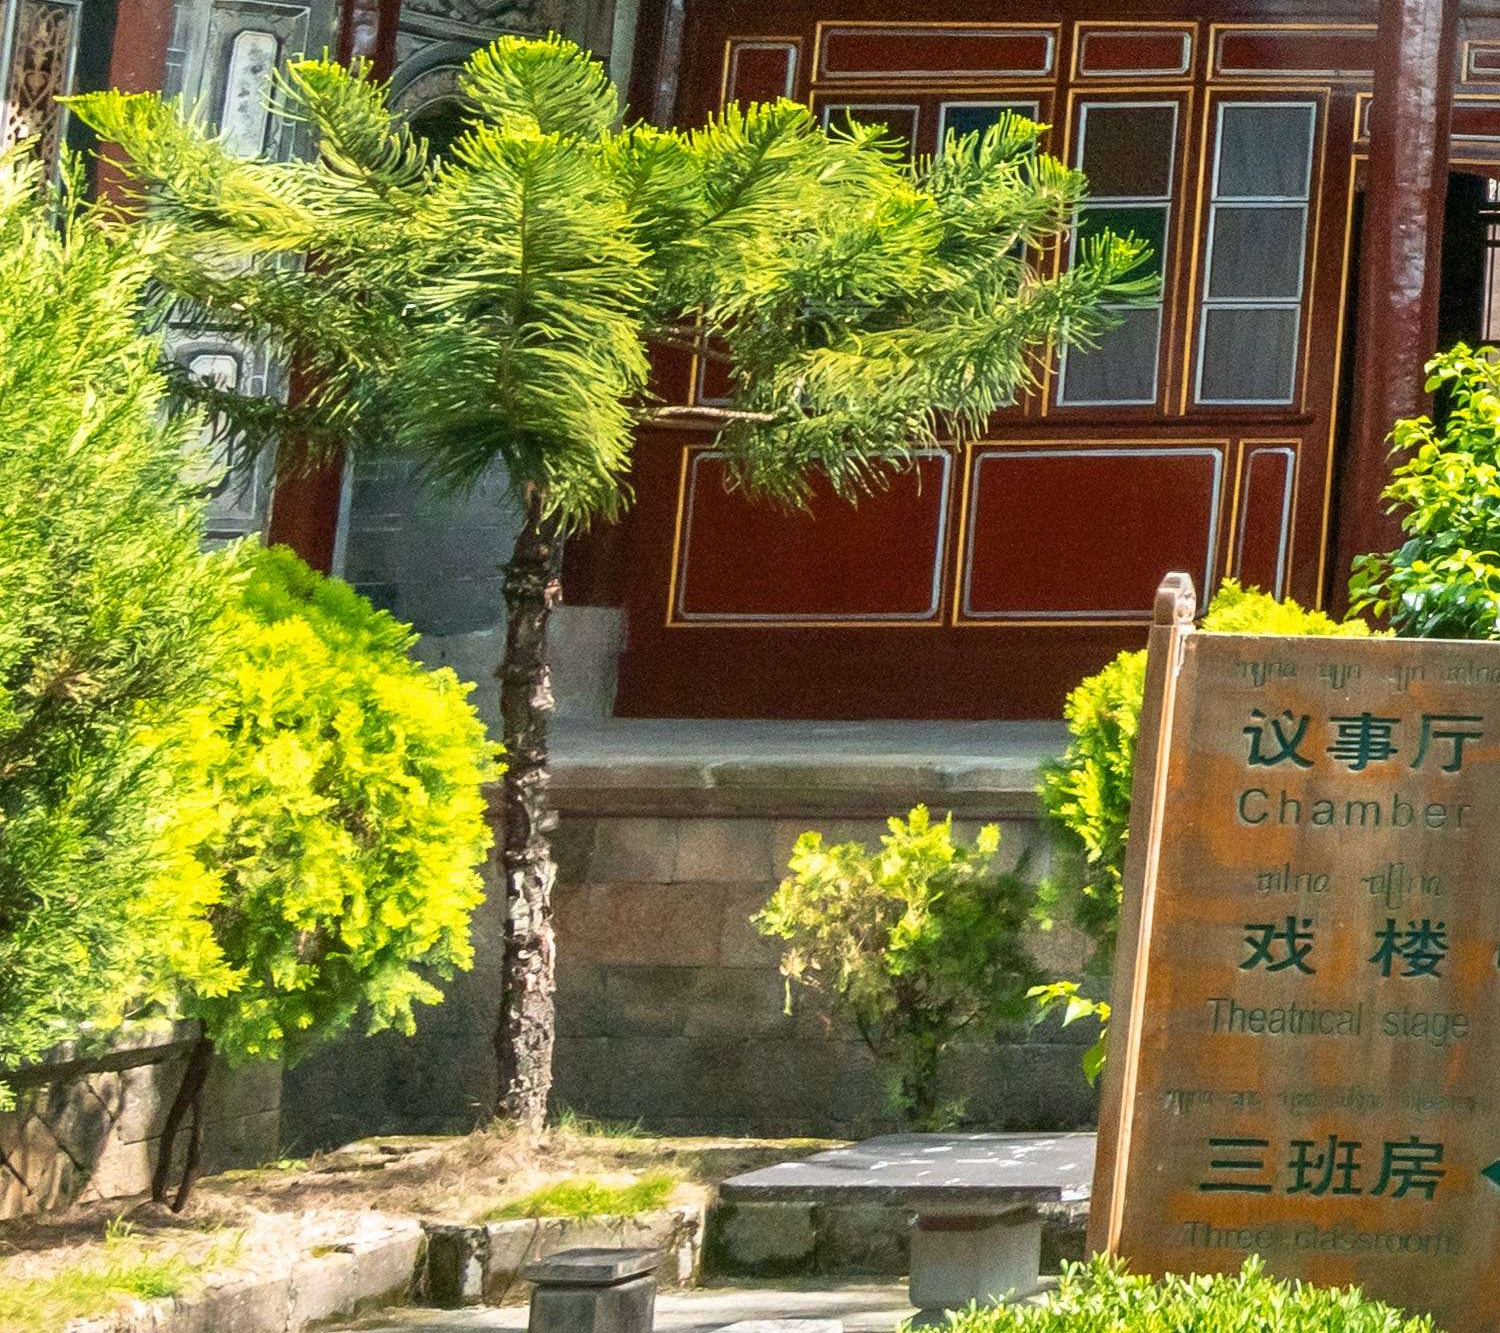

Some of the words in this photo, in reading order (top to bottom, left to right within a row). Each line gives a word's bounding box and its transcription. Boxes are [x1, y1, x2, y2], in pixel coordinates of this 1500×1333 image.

[1242, 709, 1485, 773] 议事厅
[1238, 787, 1471, 830] Chamber
[1206, 996, 1364, 1036] Theatrical
[1383, 1008, 1469, 1046] stage
[1199, 1136, 1447, 1201] 三班房
[1184, 1220, 1274, 1249] Three
